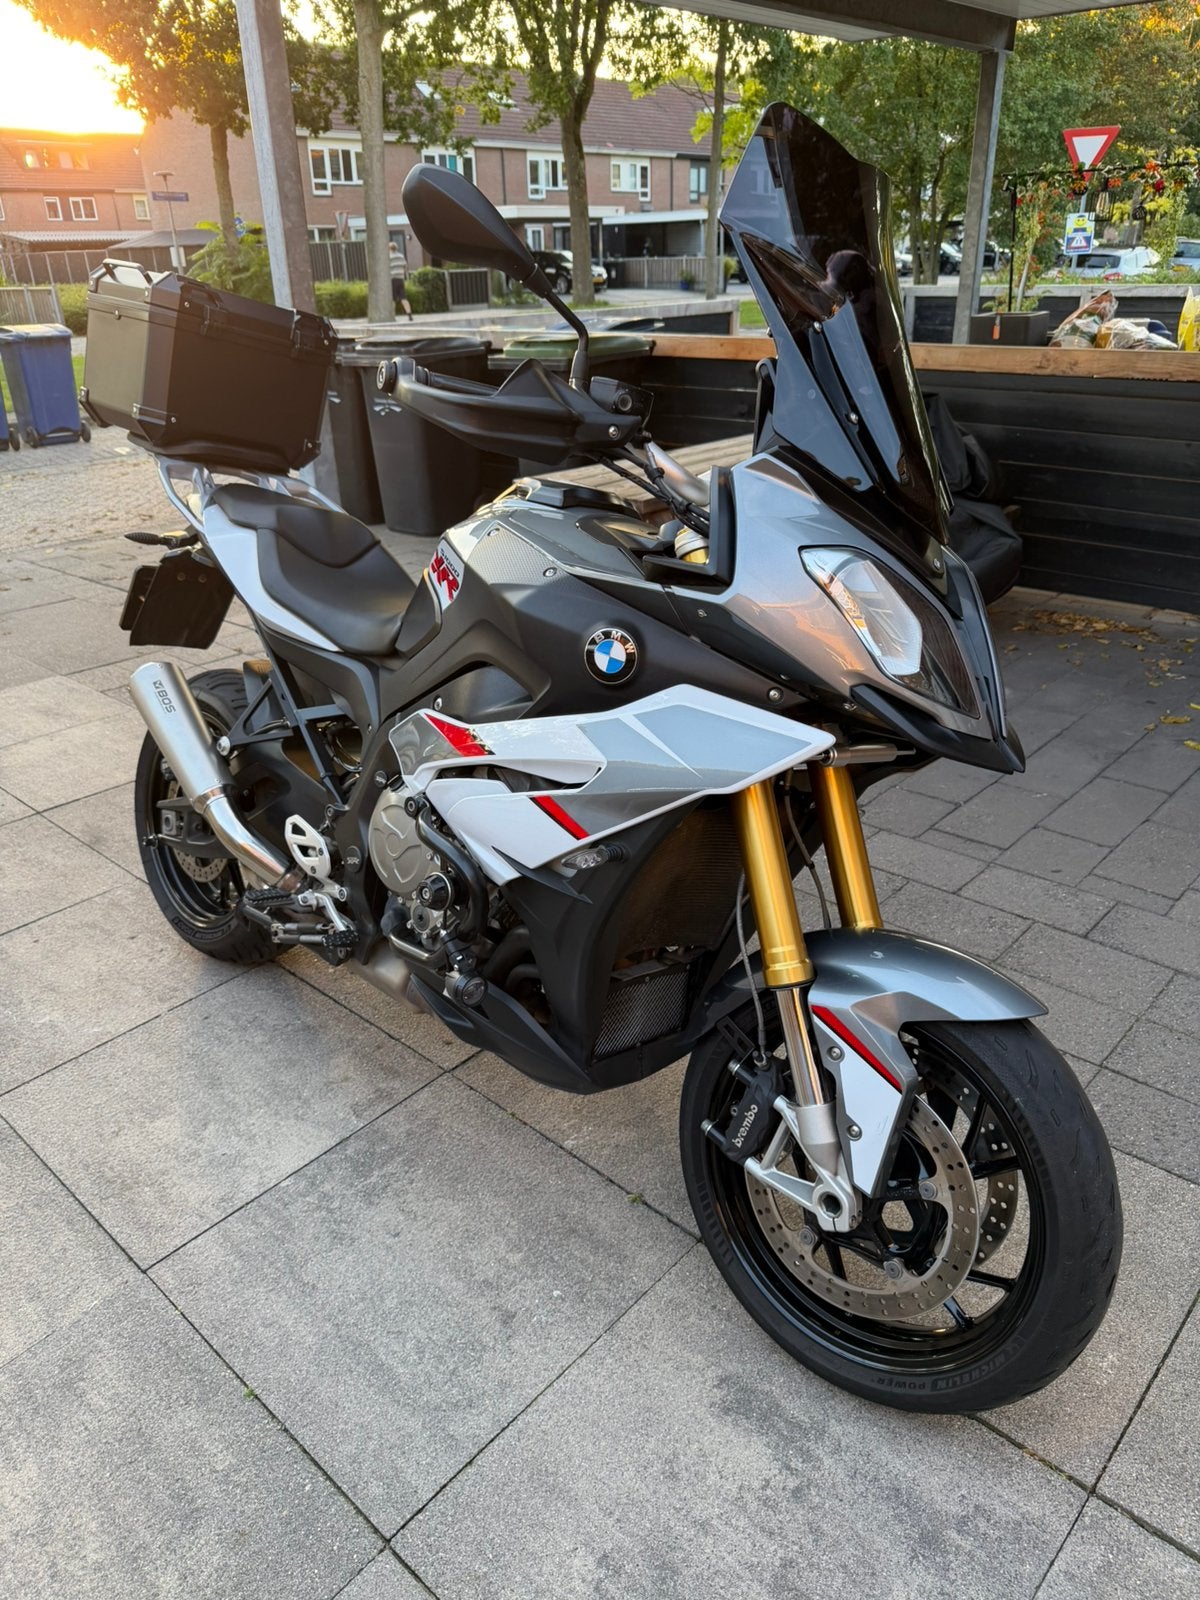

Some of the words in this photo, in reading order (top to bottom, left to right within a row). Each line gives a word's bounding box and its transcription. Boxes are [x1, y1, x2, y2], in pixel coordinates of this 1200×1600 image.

[430, 549, 460, 602] XR
[593, 630, 636, 654] BMW
[732, 1104, 758, 1148] brembo
[876, 1376, 926, 1391] POWER
[936, 1354, 1007, 1391] MICHELIN
